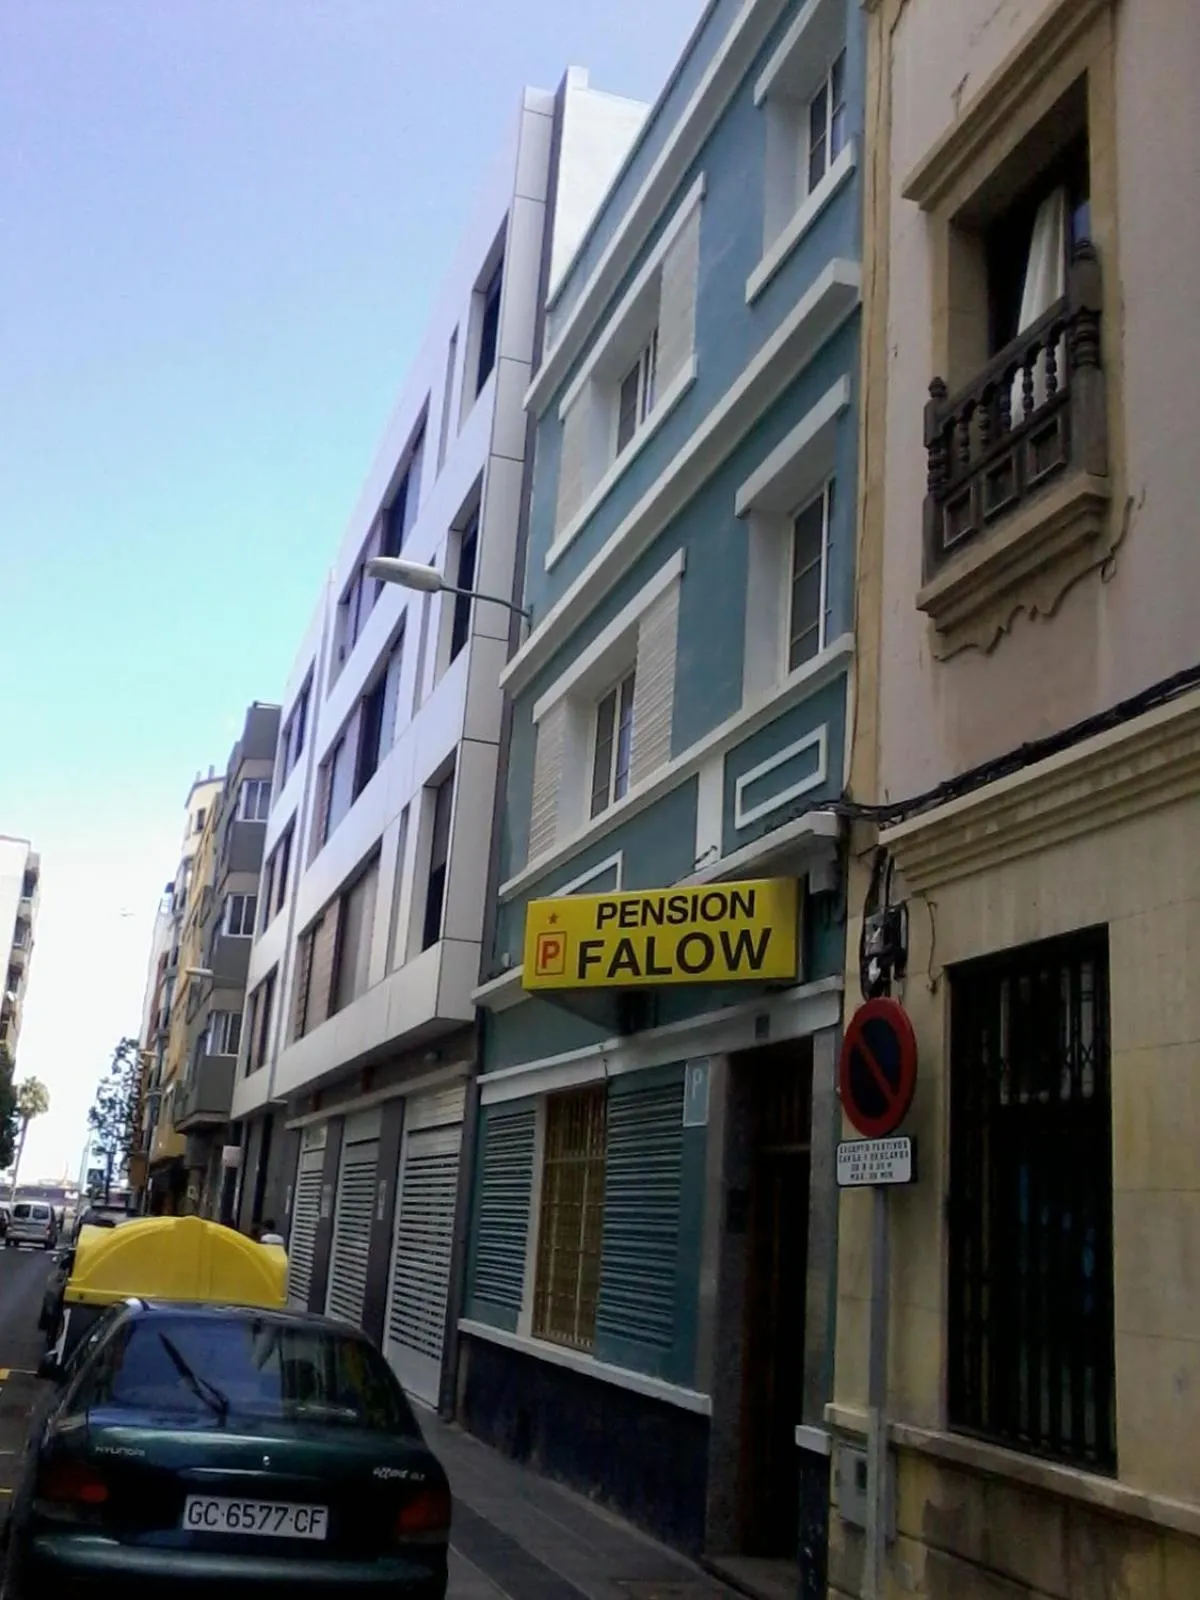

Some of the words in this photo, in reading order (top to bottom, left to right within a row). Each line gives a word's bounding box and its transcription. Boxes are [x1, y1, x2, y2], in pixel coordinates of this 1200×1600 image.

[596, 889, 755, 930] PENSION
[540, 941, 560, 969] P
[577, 927, 772, 979] FALOW
